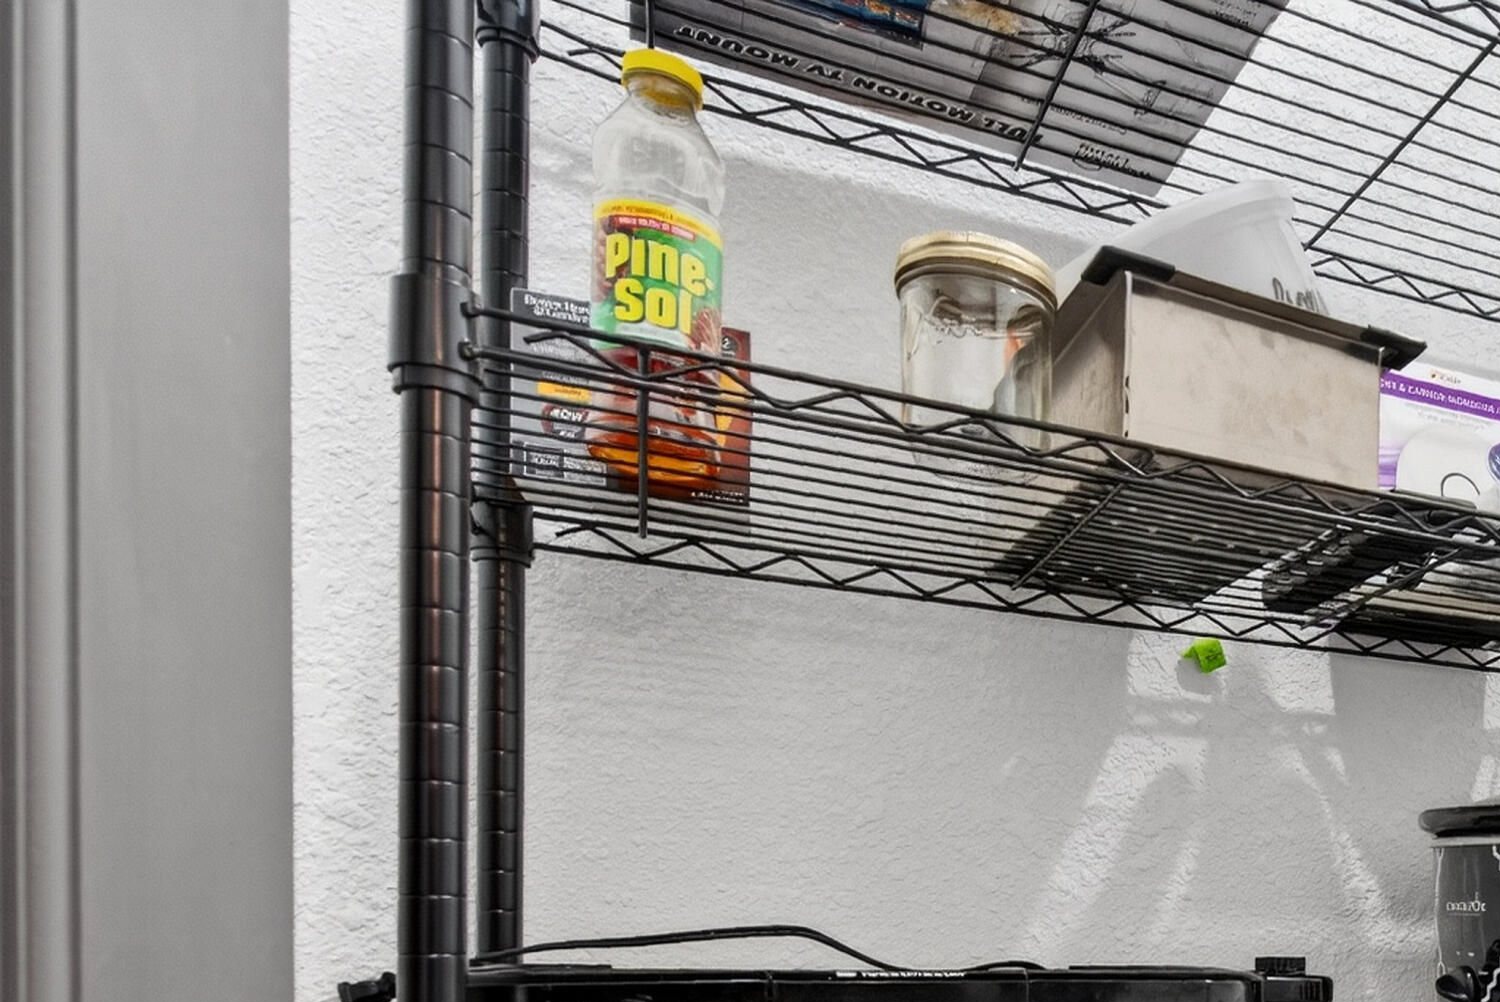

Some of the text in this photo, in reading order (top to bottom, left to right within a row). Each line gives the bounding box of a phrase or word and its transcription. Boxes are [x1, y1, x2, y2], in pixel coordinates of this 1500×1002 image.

[673, 24, 800, 68] MOUNT
[804, 63, 844, 82] TV
[853, 75, 975, 122] MOTION
